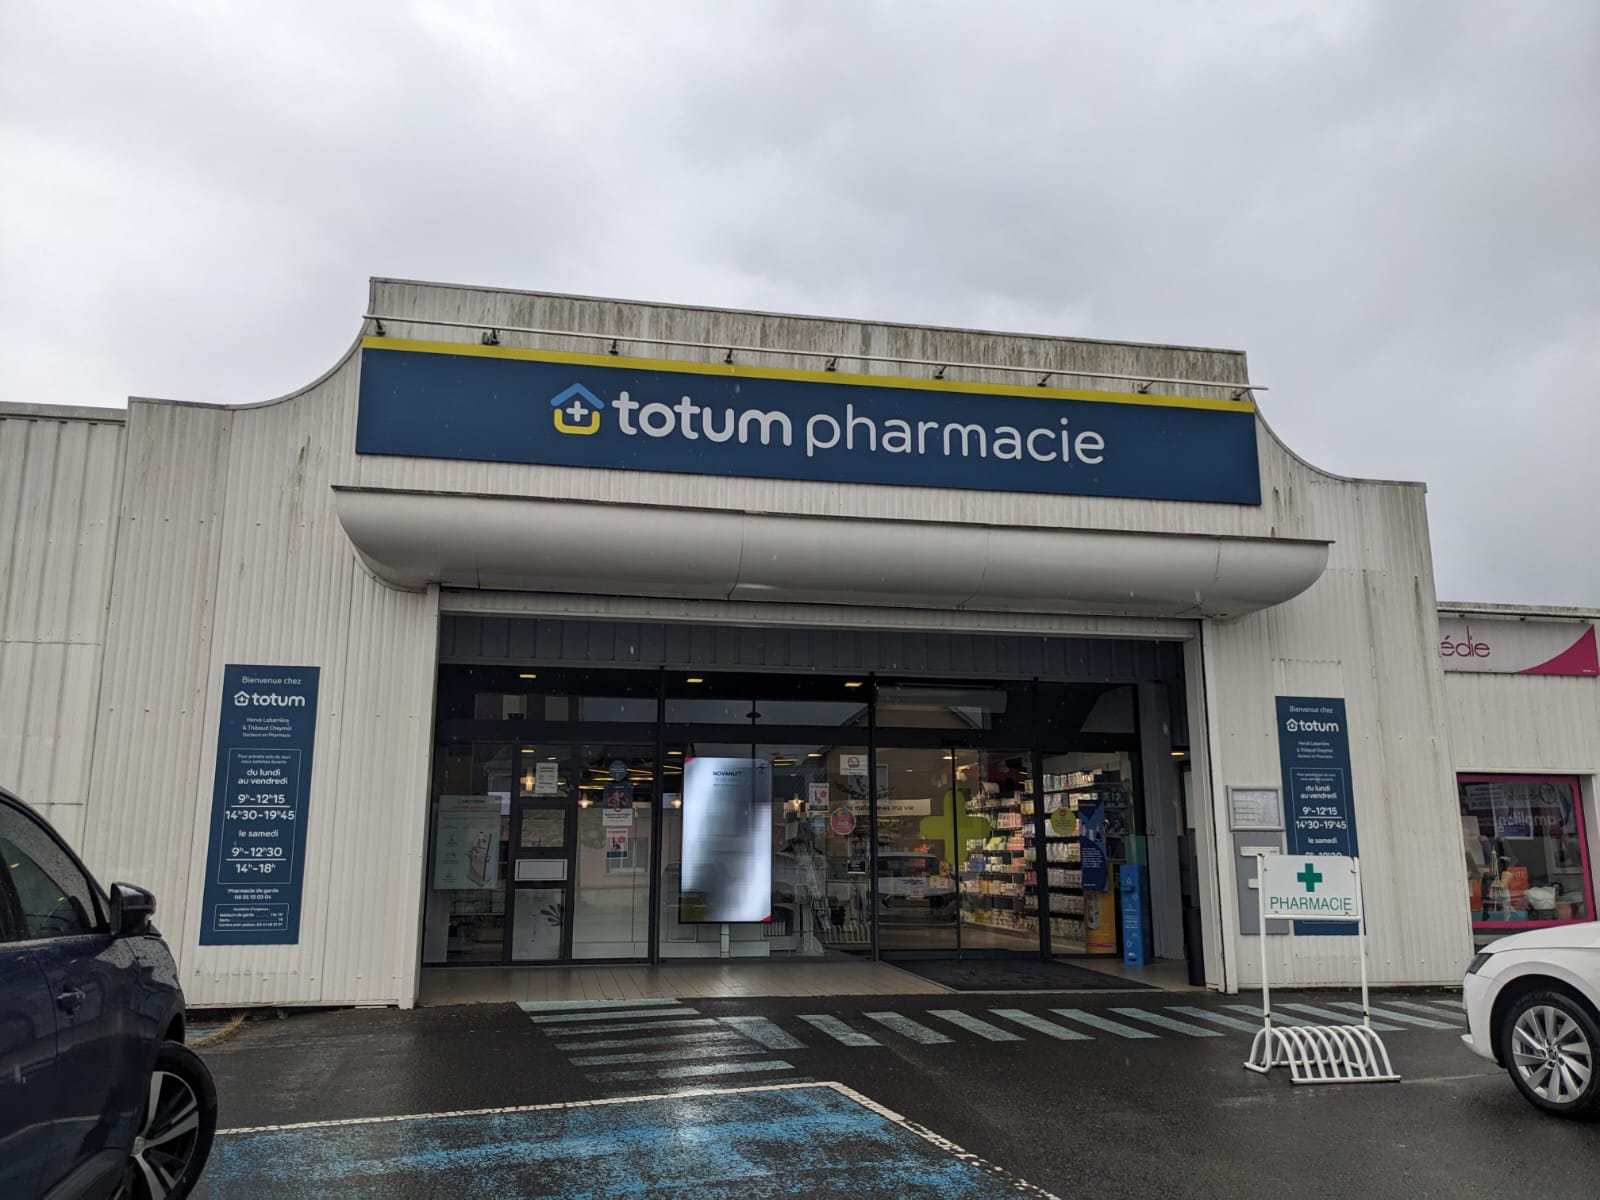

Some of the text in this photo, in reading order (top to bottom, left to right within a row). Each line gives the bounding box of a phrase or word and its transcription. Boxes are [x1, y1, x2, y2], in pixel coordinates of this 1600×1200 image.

[611, 391, 1105, 465] totum pharmacie
[242, 675, 302, 685] Bienvenue chez
[251, 692, 306, 707] totum
[1319, 705, 1334, 714] chez
[1299, 720, 1340, 733] totum
[259, 768, 281, 776] lundi
[250, 777, 288, 785] vendredi
[1310, 791, 1338, 799] vendredi
[238, 829, 279, 838] le samedi
[1308, 836, 1338, 844] le samedi
[1269, 896, 1353, 911] PHARMACIE
